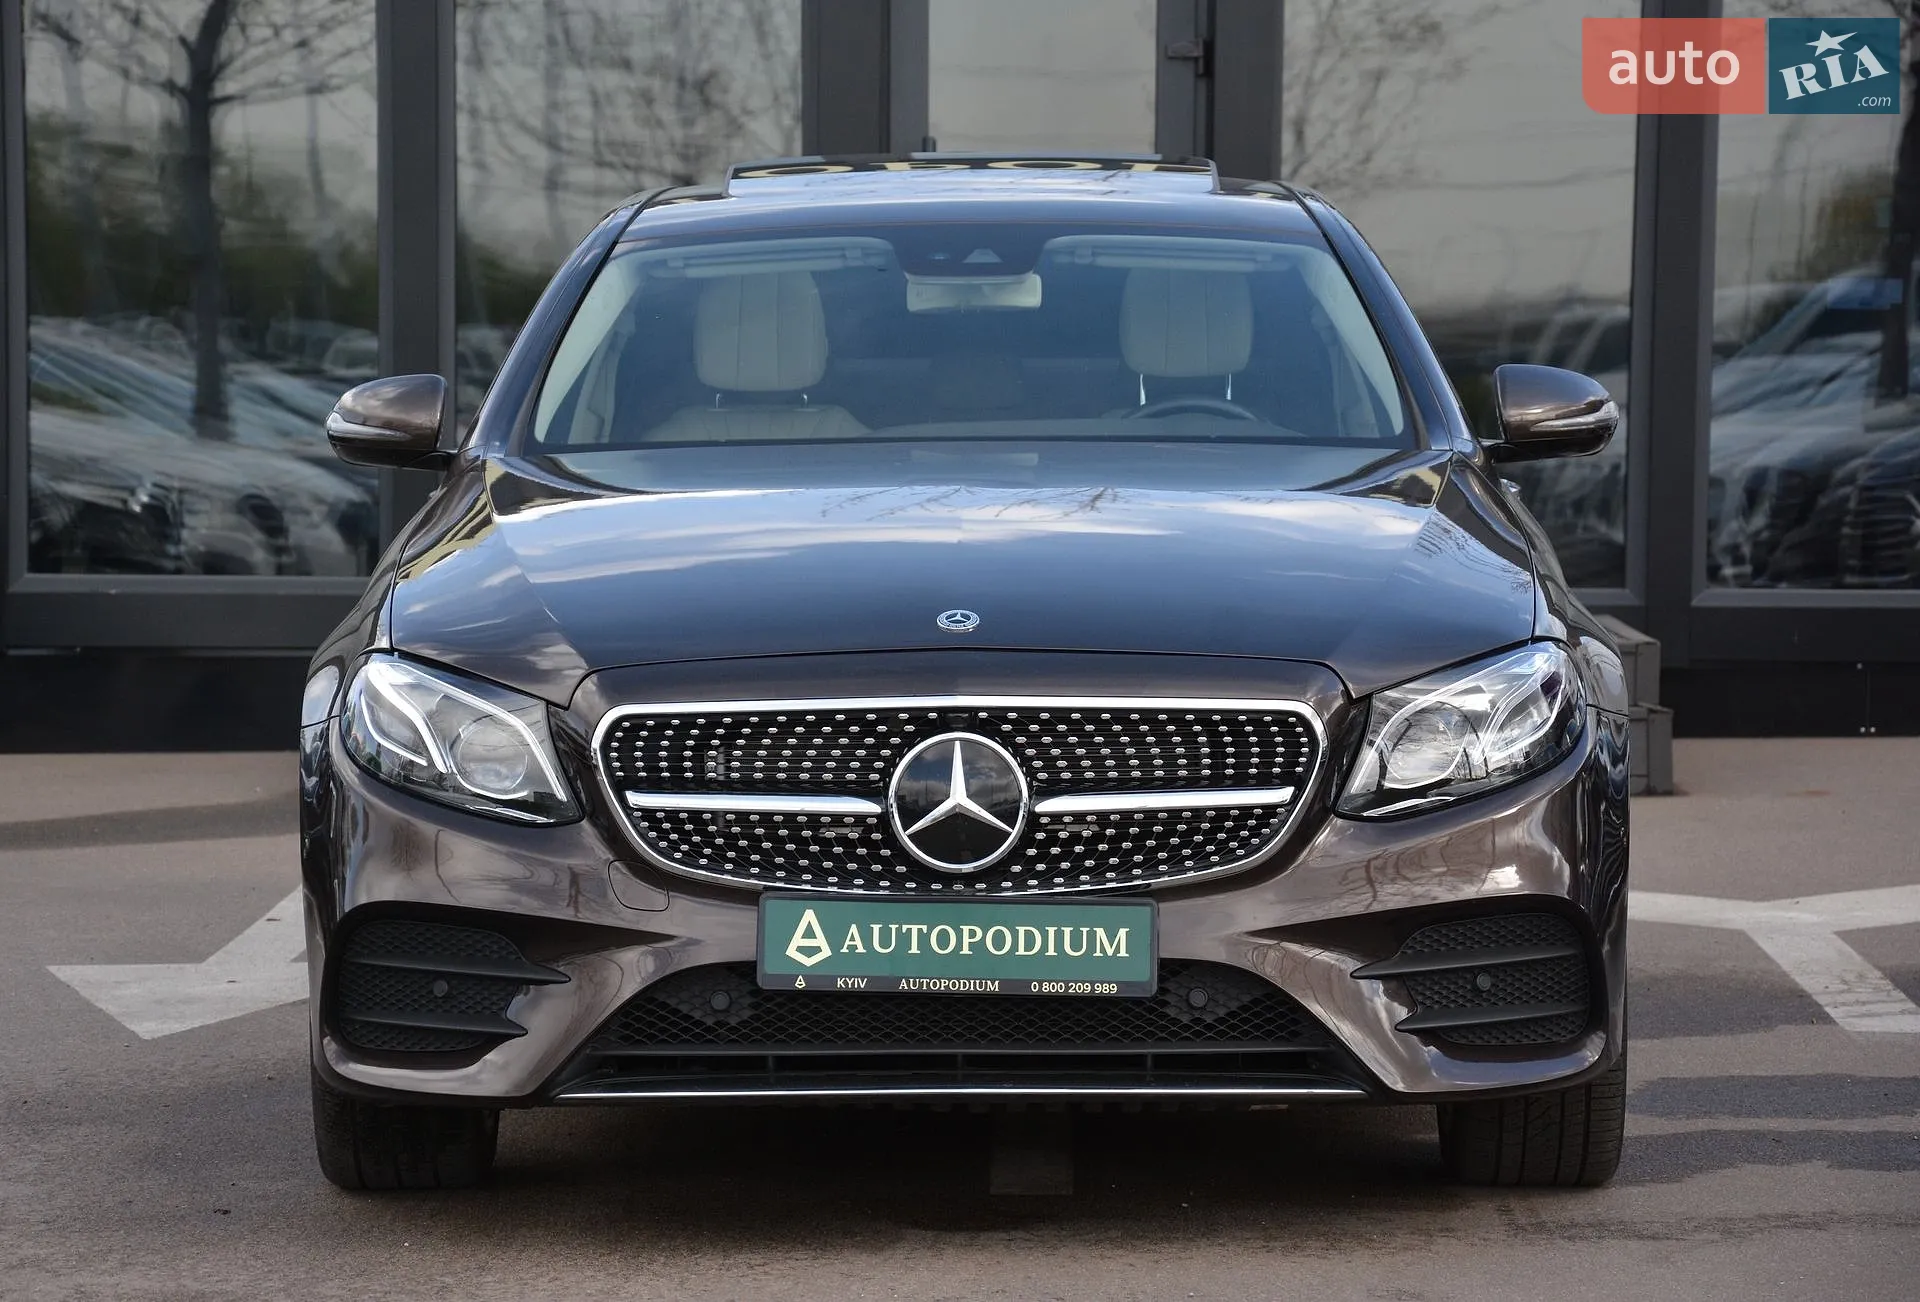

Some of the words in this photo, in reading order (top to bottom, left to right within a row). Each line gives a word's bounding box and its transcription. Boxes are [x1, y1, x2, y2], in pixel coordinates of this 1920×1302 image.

[840, 924, 1130, 957] AUTOPODIUM
[836, 977, 868, 989] KYIV
[898, 978, 1000, 992] AUTOPODIUM
[1031, 981, 1039, 992] 0
[1042, 981, 1065, 993] 800
[1068, 982, 1092, 994] 209
[1094, 982, 1118, 994] 989
